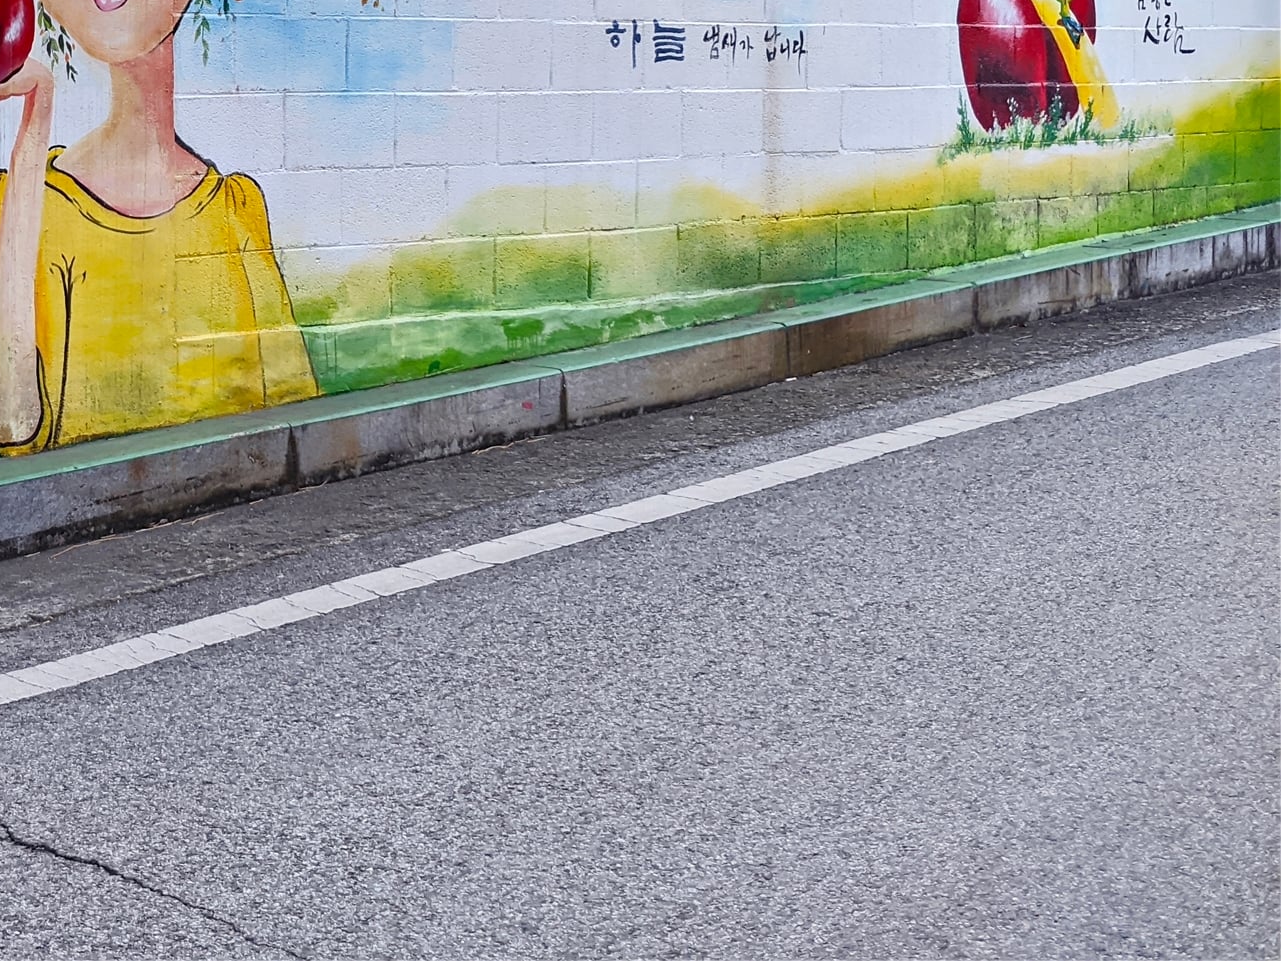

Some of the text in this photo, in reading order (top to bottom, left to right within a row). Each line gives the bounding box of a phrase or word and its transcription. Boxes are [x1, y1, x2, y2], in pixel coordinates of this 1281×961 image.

[605, 18, 809, 75] 하늘 냄새가 납니다
[1142, 11, 1197, 55] 사람
